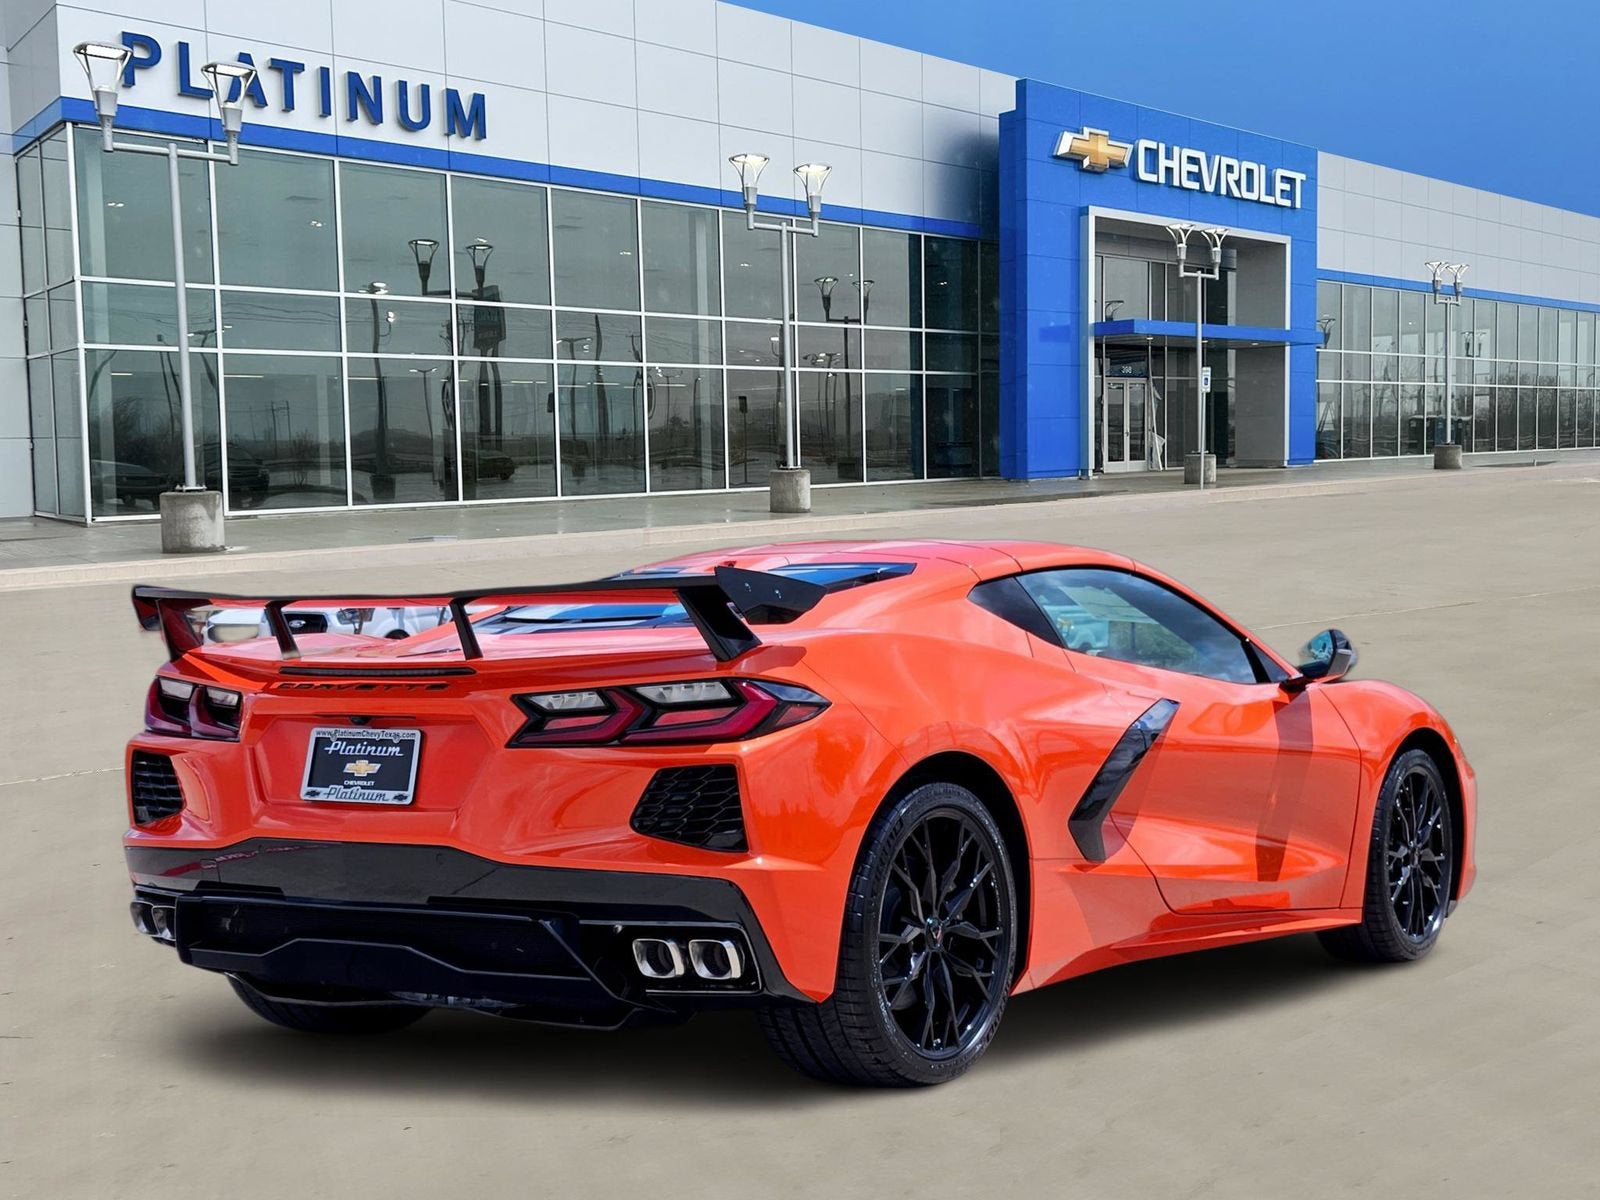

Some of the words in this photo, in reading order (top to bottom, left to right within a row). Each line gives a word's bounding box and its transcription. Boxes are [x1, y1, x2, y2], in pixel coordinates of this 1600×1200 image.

[121, 31, 487, 140] PLATINUM
[1136, 138, 1306, 208] CHEVROLET
[316, 729, 416, 739] www.PlatinumChevyTexas.com
[324, 740, 404, 756] Platinum
[324, 786, 389, 801] Platinum
